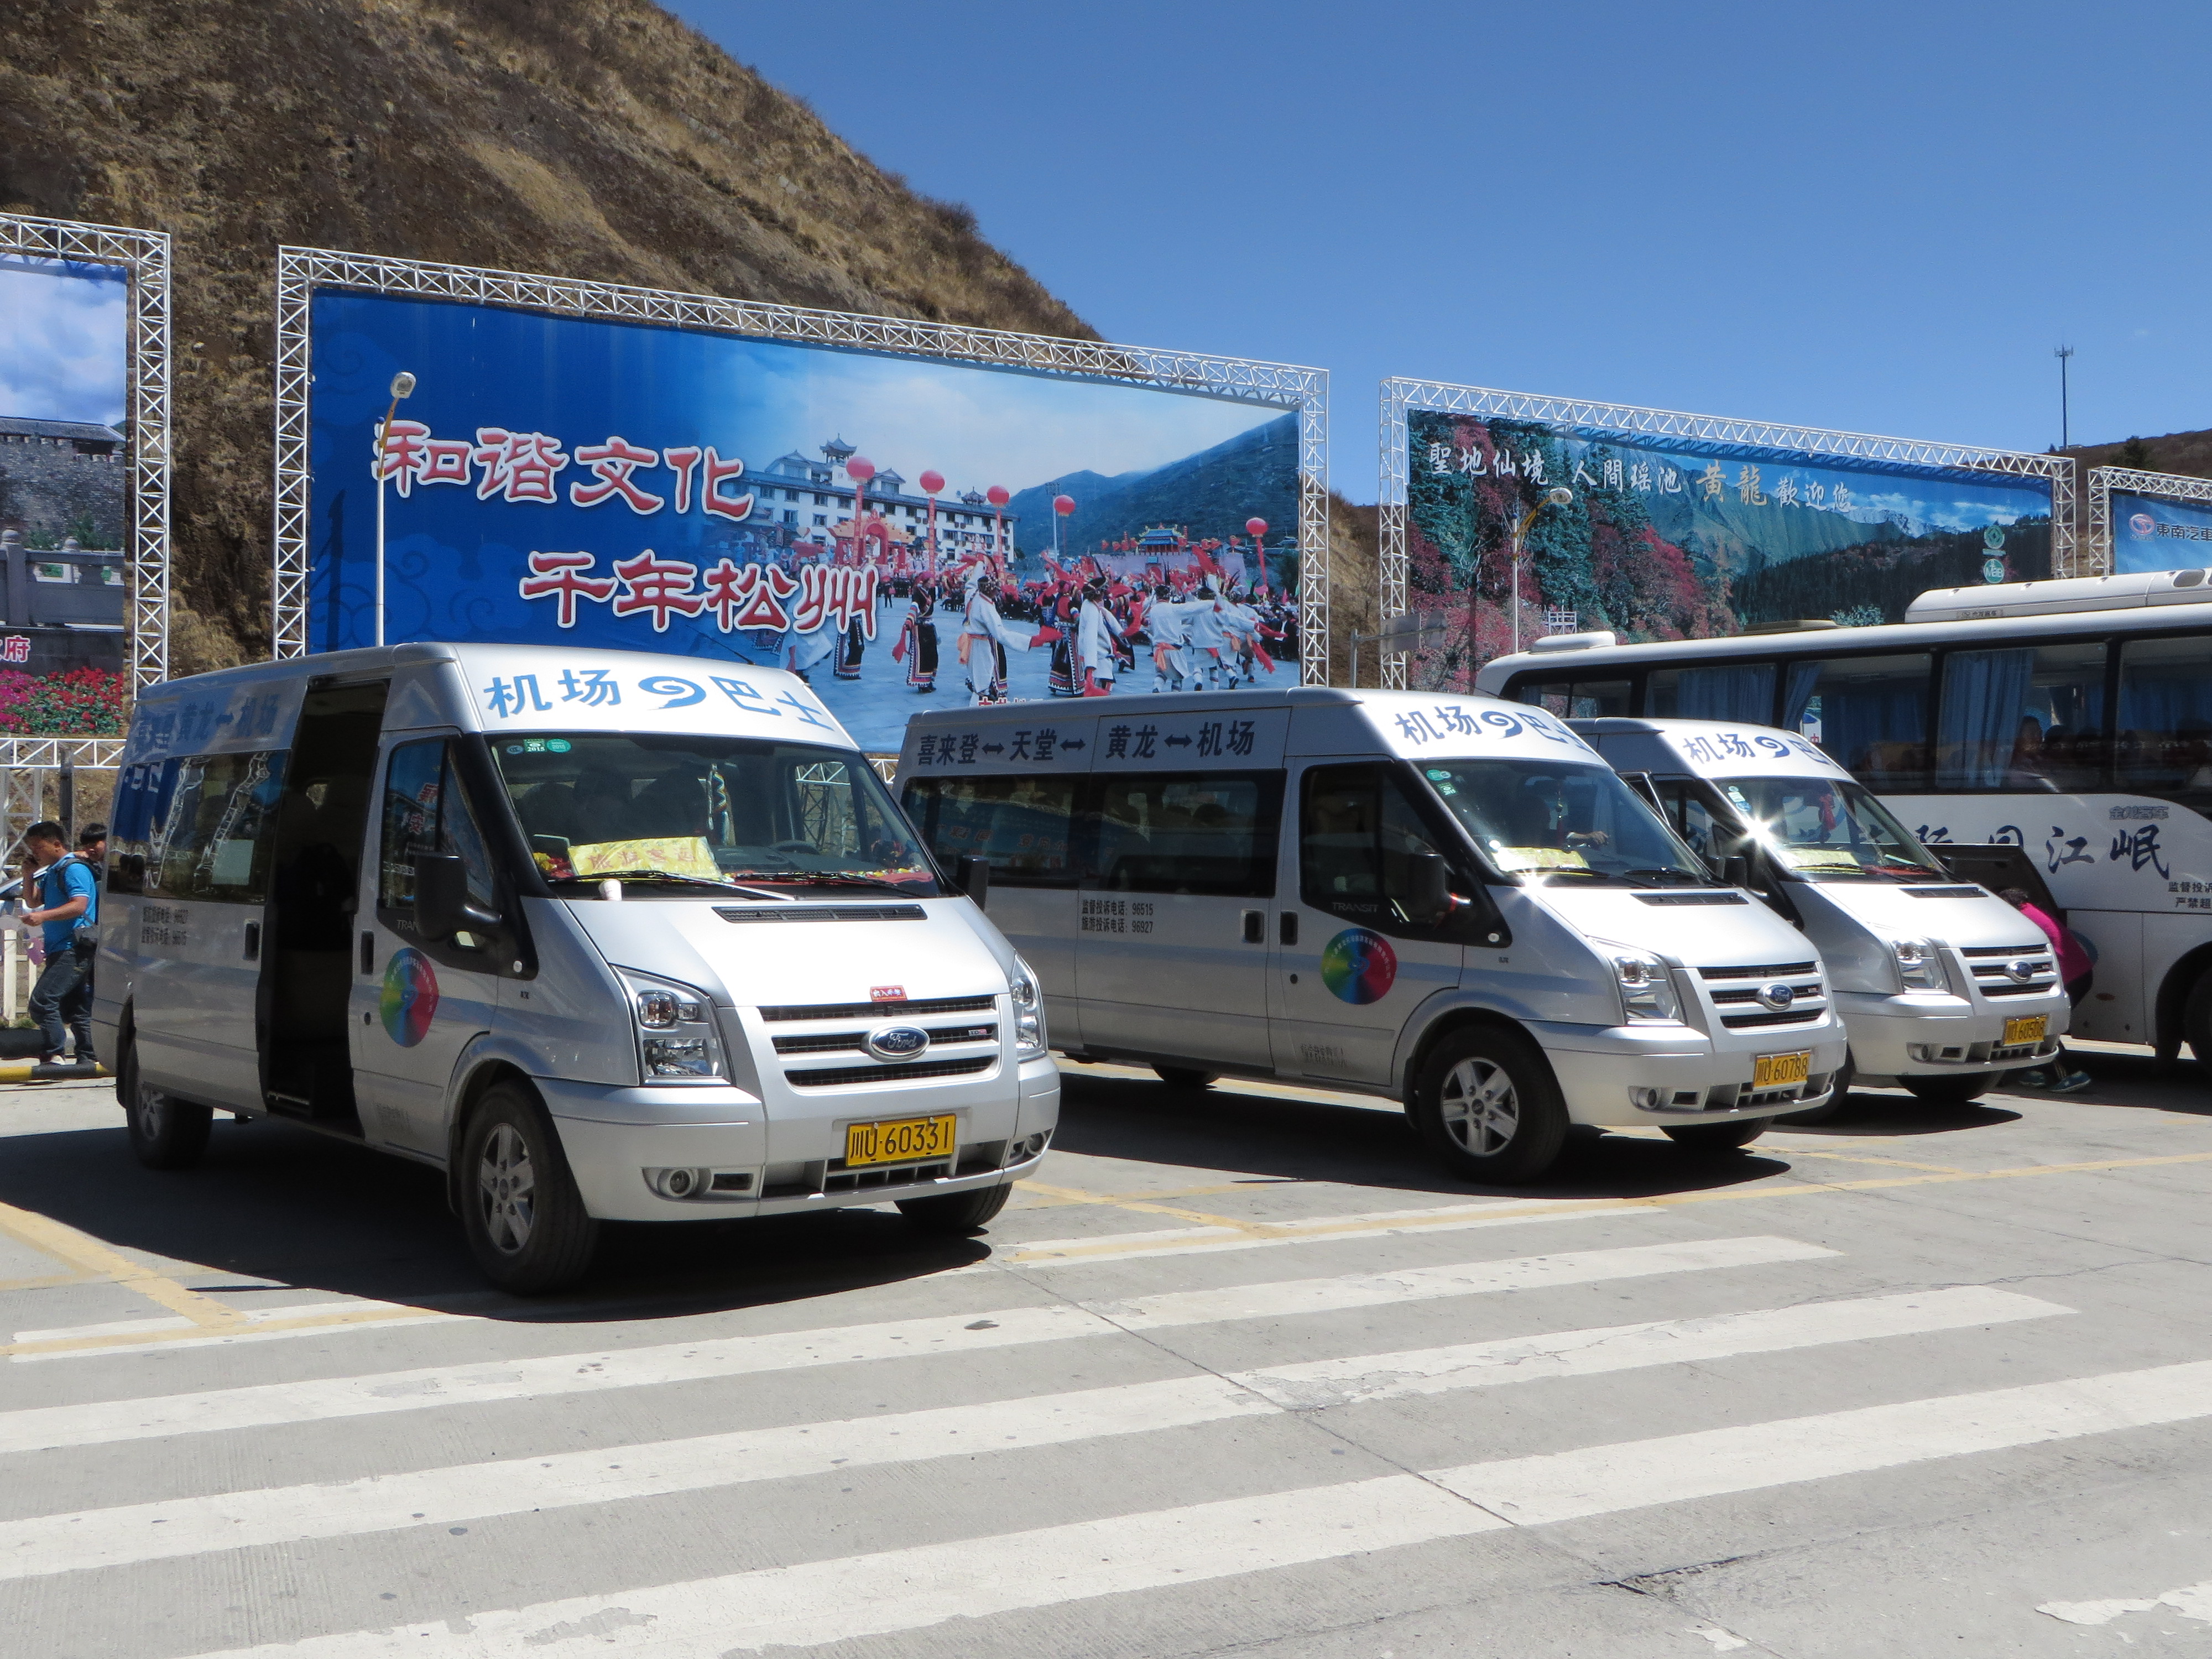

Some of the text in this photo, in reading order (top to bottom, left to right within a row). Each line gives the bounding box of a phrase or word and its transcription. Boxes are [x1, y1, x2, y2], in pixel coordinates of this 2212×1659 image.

[371, 419, 754, 521] 和谐文化
[2156, 523, 2212, 542] 東南汽車
[520, 549, 878, 640] 千年松州
[0, 635, 31, 662] 府
[483, 669, 835, 731] 机场 巴士
[1394, 706, 1482, 745] 机场
[917, 720, 1255, 766] 喜来登 天堂 黄龙 机场
[1683, 733, 1756, 764] 机场
[1131, 902, 1154, 916] 96515
[1332, 902, 1380, 914] TRANSIT
[1131, 920, 1154, 933] 96927
[887, 1032, 917, 1050] Ford
